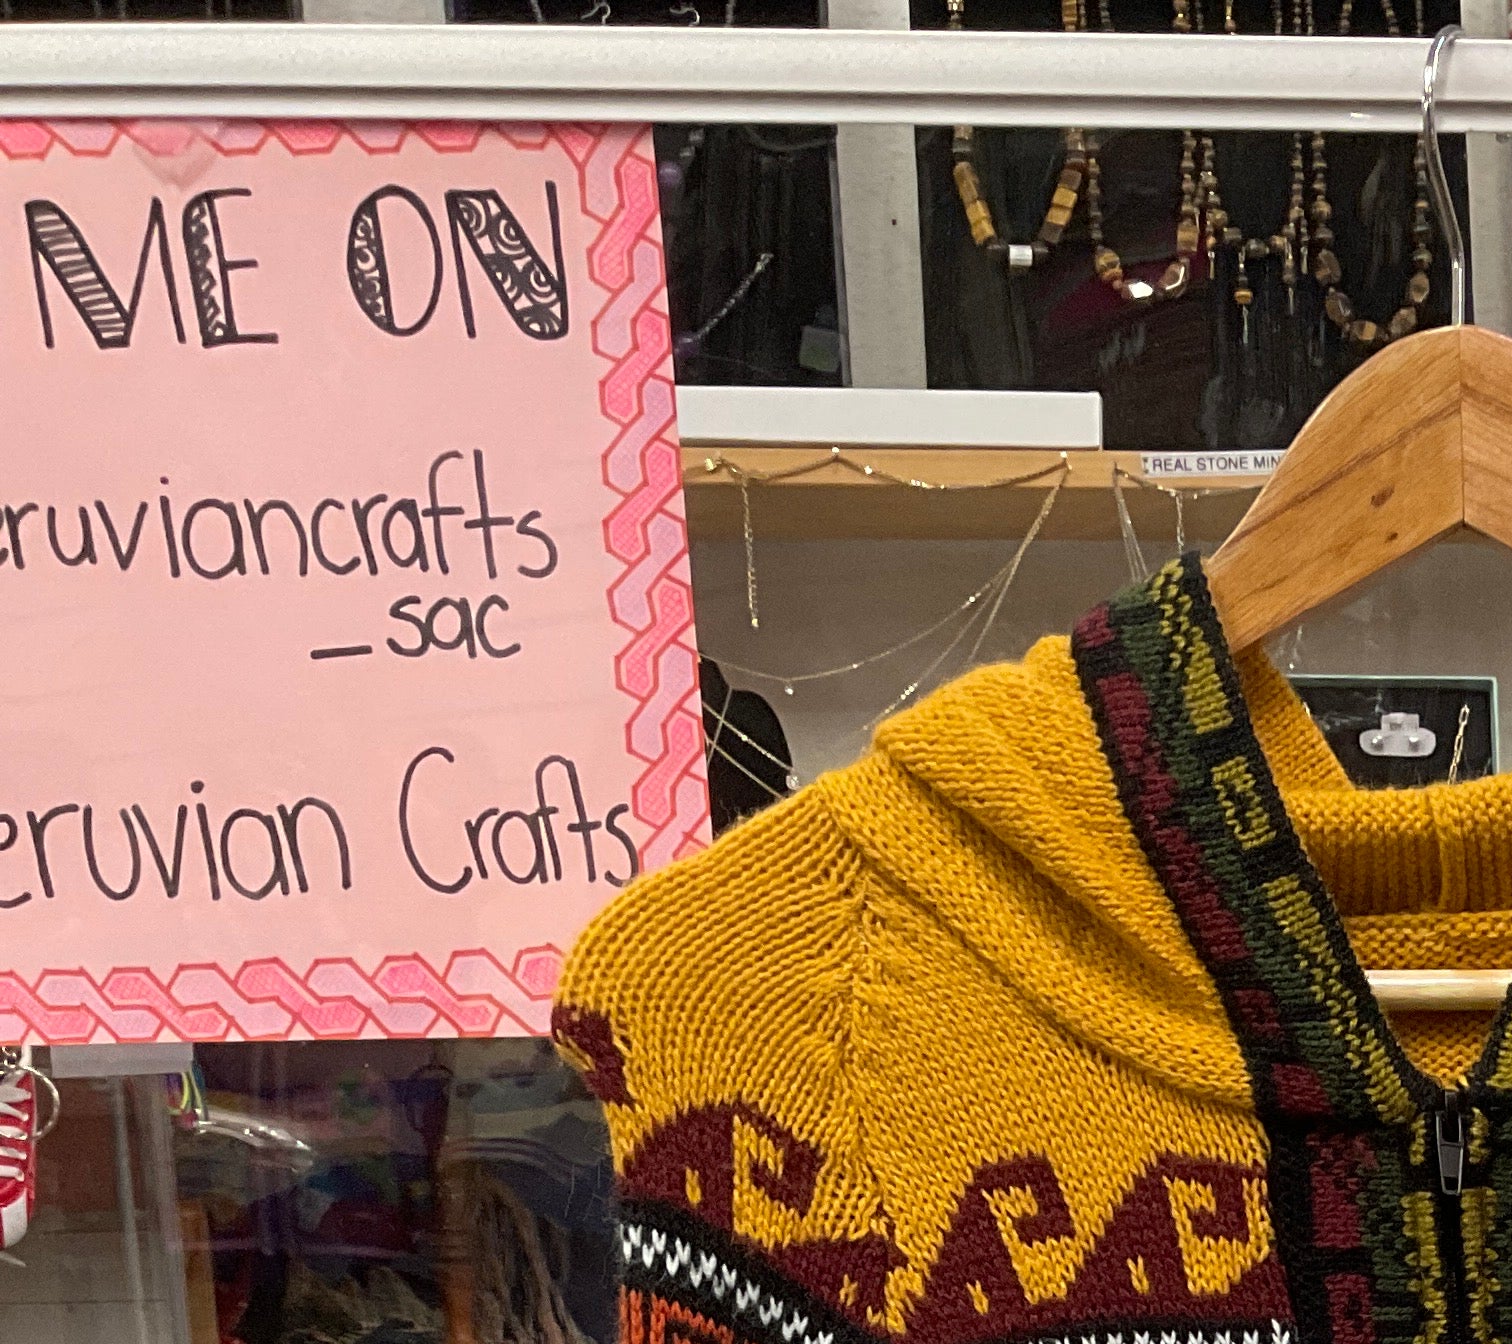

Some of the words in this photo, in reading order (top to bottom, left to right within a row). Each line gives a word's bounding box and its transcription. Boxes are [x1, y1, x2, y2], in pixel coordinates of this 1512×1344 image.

[24, 189, 278, 349] ME
[346, 180, 569, 340] ON
[0, 449, 558, 579] ruviancrafts
[1152, 457, 1192, 472] REAL
[1196, 456, 1249, 471] STONE
[400, 747, 639, 895] Crafts
